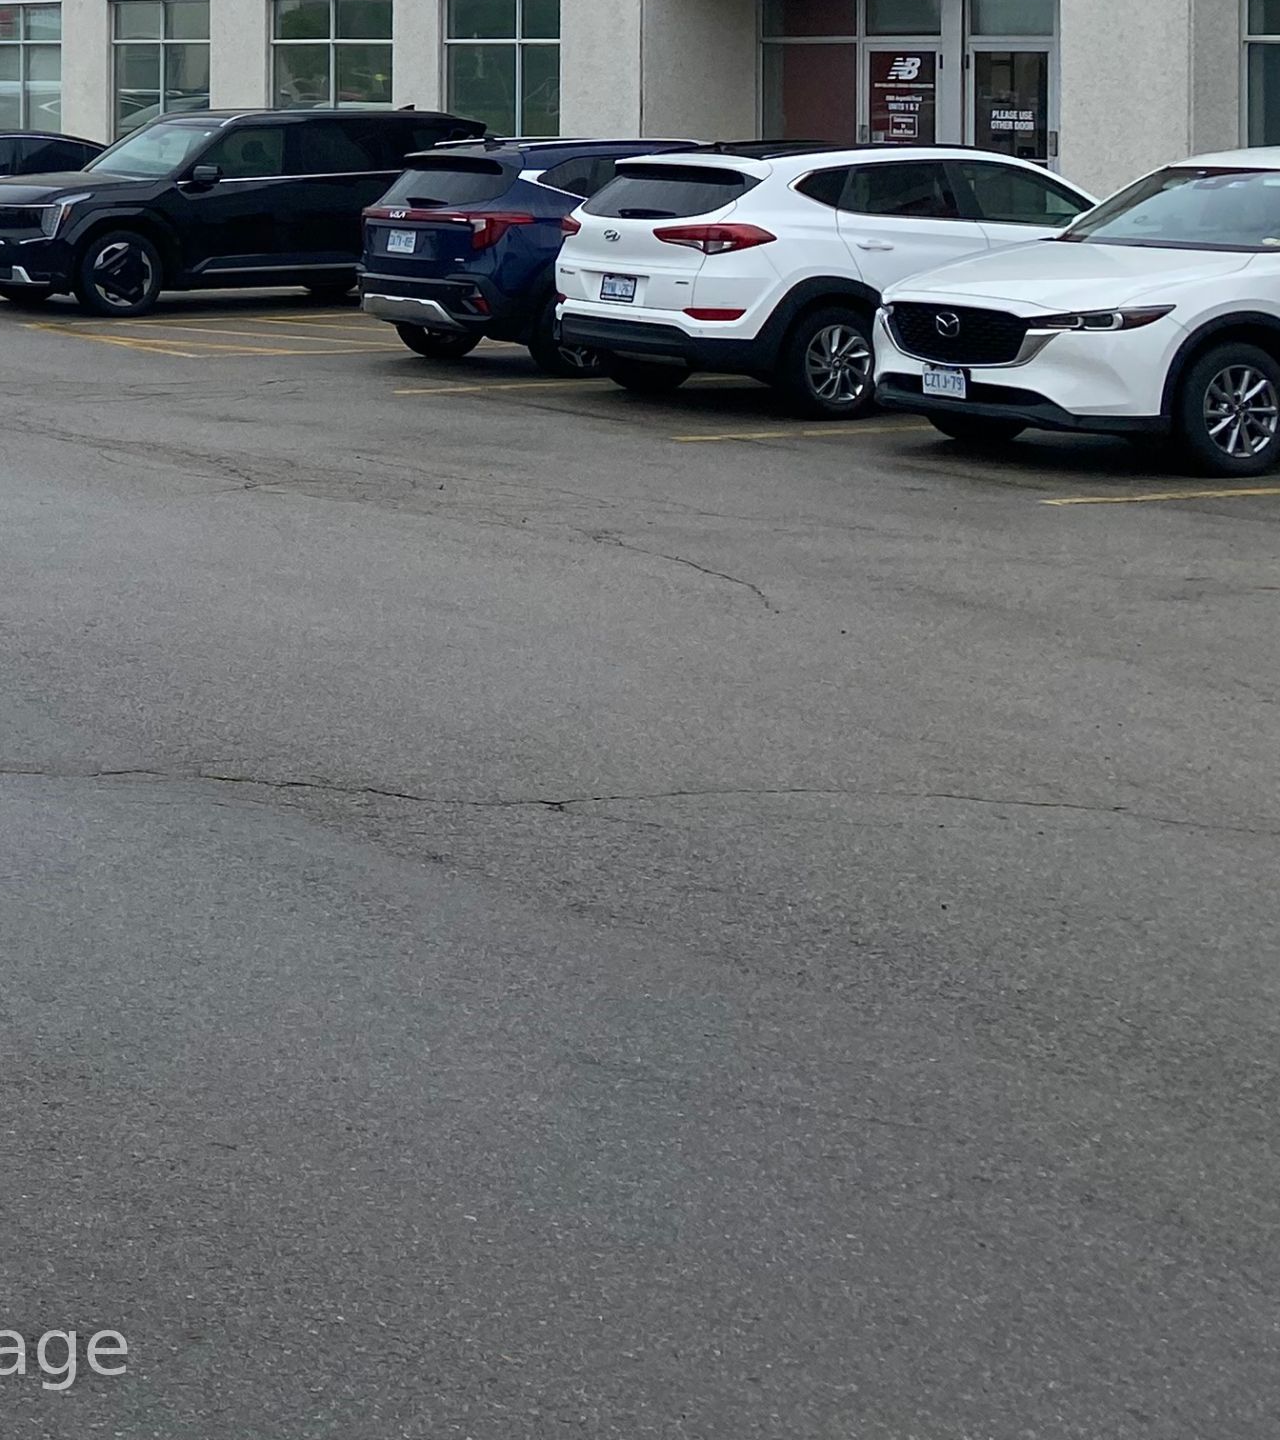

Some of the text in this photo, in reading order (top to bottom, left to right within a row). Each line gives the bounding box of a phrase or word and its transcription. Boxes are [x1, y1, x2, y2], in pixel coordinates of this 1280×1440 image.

[991, 110, 1034, 120] PLEASE USE
[990, 120, 1034, 130] OTHER DOOR
